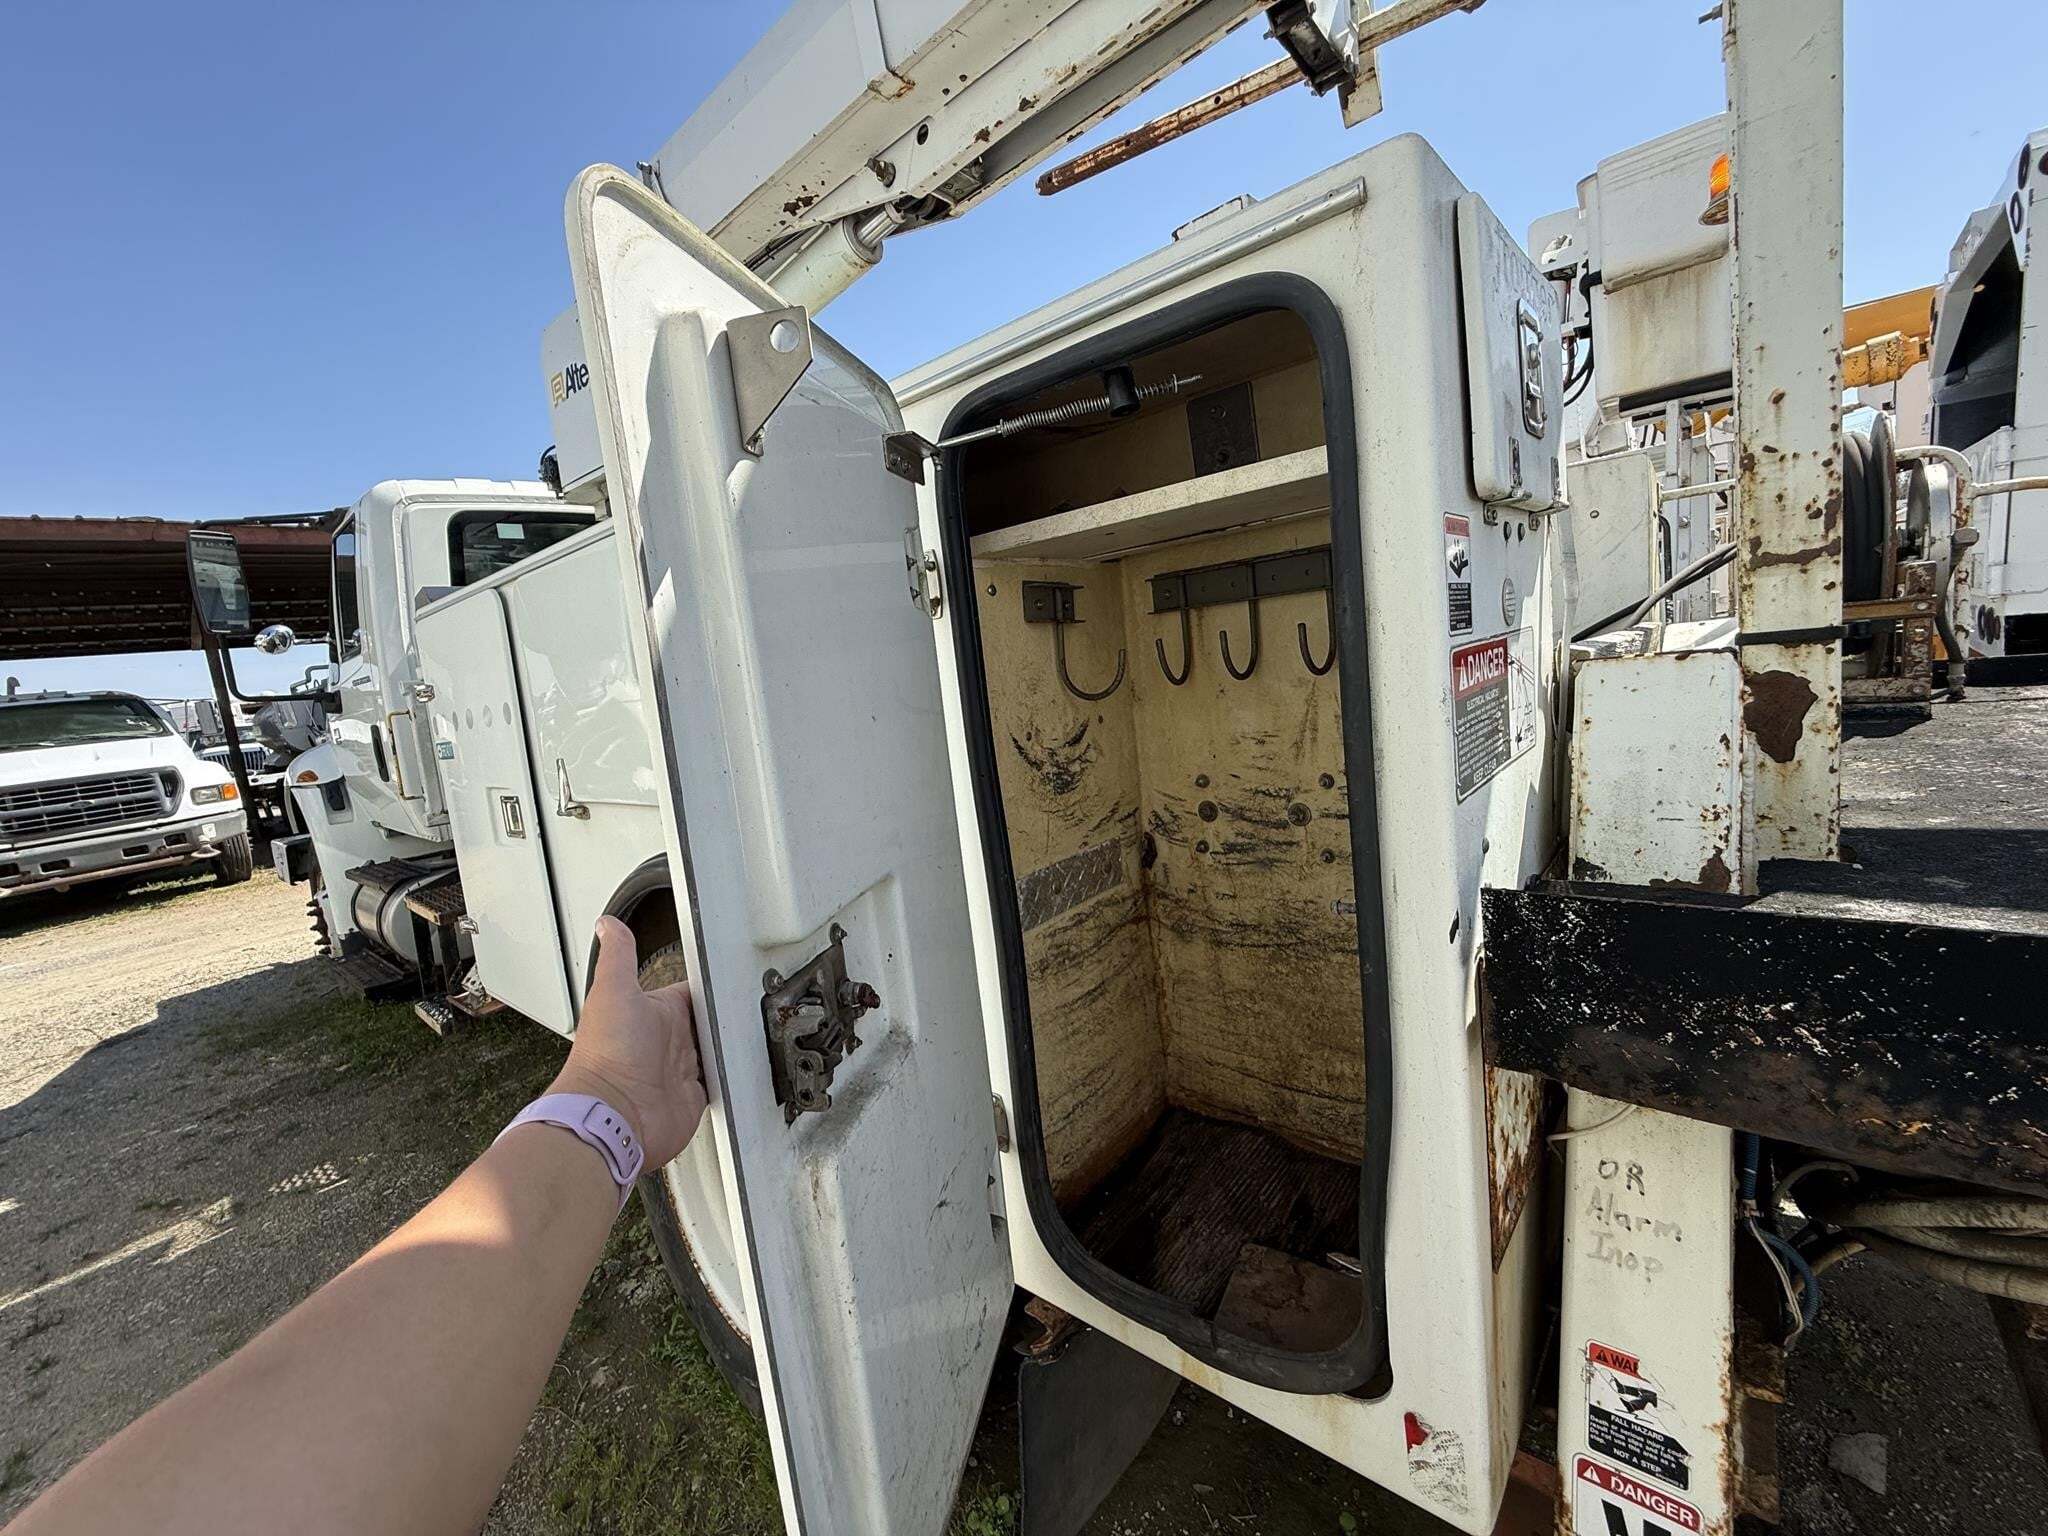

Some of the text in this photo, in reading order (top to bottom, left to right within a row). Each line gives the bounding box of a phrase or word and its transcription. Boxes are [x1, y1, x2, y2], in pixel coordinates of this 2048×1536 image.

[566, 363, 589, 399] Alte
[1467, 647, 1505, 685] DANGER
[1598, 1160, 1645, 1196] OR
[1584, 1186, 1682, 1243] Alarm
[1590, 1415, 1608, 1427] Death
[1620, 1428, 1644, 1442] serious
[1590, 1426, 1598, 1435] Do
[1601, 1432, 1611, 1440] not
[1613, 1437, 1625, 1446] use
[1628, 1443, 1640, 1453] this
[1643, 1449, 1657, 1461] area
[1660, 1457, 1667, 1465] as
[1610, 1429, 1625, 1440] from
[1645, 1444, 1658, 1454] and
[1611, 1415, 1664, 1442] FALL HAZARD
[1613, 1447, 1661, 1472] NOT A STEP
[1610, 1475, 1693, 1527] DANGER
